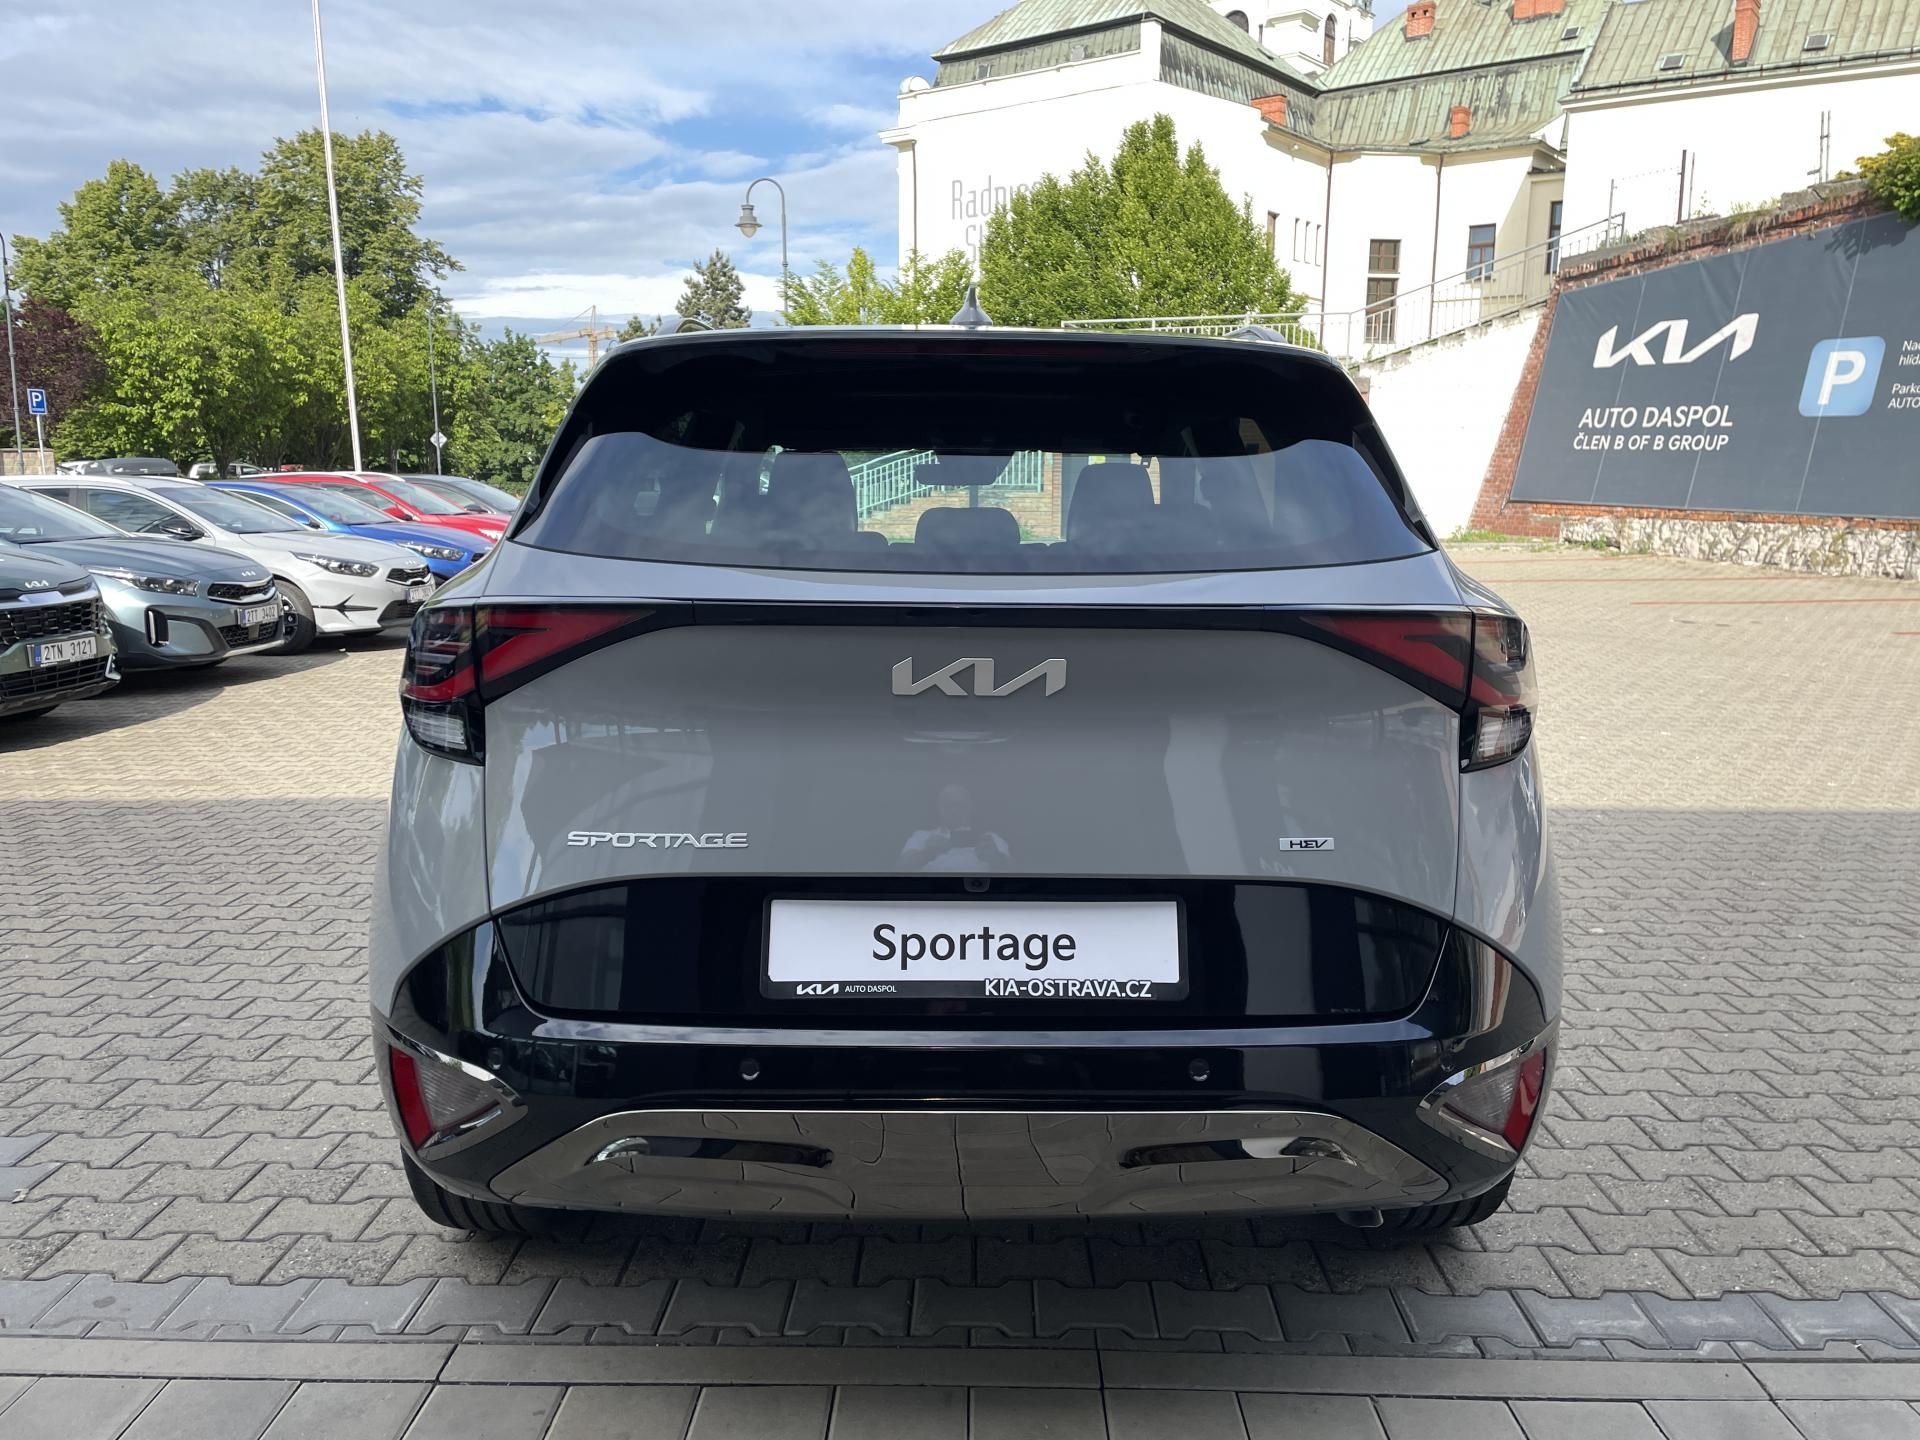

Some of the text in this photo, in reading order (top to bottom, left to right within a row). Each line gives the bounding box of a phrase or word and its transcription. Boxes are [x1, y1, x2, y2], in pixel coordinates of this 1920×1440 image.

[952, 175, 1043, 220] Radni
[1593, 313, 1759, 368] KIA
[1817, 350, 1866, 405] P
[31, 392, 42, 407] P
[1887, 397, 1920, 409] AUTO
[1578, 405, 1733, 428] AUTO DASPOL
[1573, 432, 1729, 451] ČLEN B OF B GROUP
[44, 639, 92, 661] 2TN 3121
[892, 656, 1067, 697] KIA
[567, 831, 749, 849] SPORTAGE
[1289, 839, 1328, 849] HEV
[872, 923, 1077, 971] Sportage
[796, 983, 839, 995] KIA
[844, 985, 897, 993] AUTO DASPOL
[985, 978, 1152, 998] KIA-OSTRAVA.CZ
